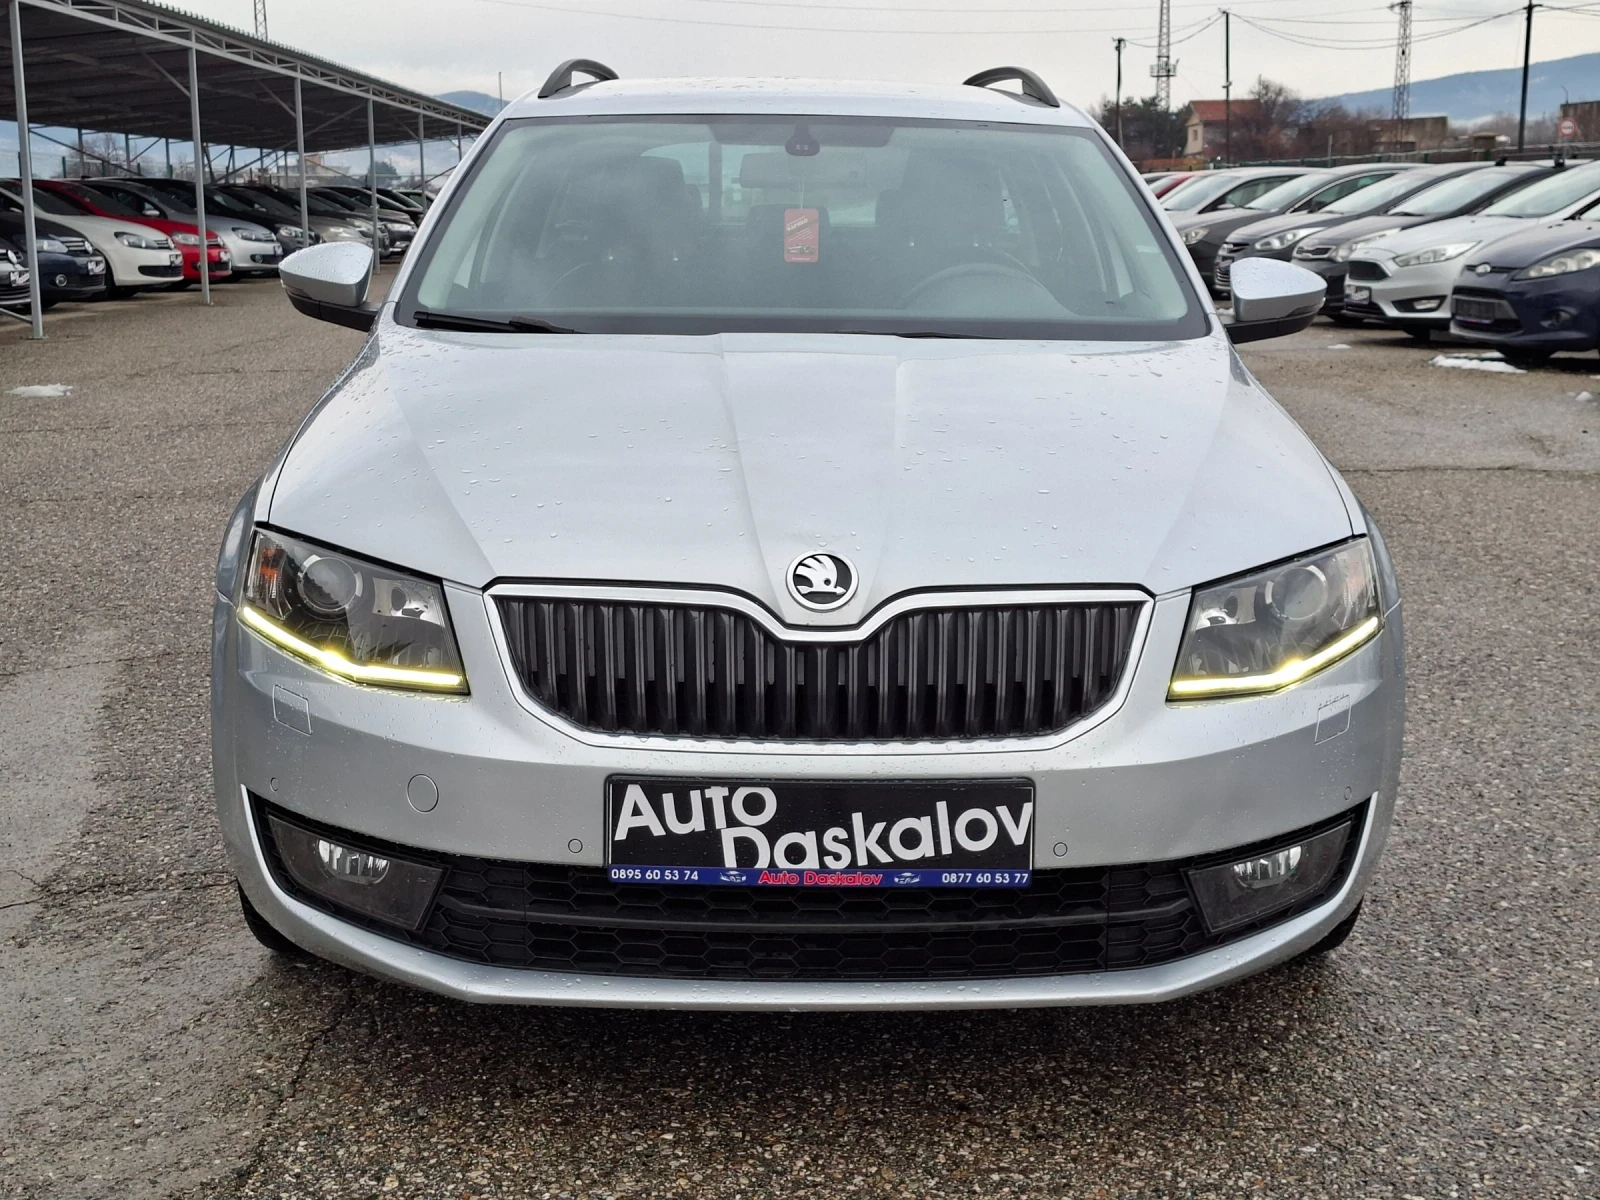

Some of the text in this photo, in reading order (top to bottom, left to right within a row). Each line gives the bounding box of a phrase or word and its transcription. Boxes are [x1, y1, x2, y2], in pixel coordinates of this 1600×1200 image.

[614, 784, 777, 841] Auto
[720, 801, 1032, 870] Daskalov
[611, 868, 699, 881] 0895 60 53 74
[758, 870, 883, 886] Auto Daskalov
[941, 872, 1029, 884] 0877 60 53 77
